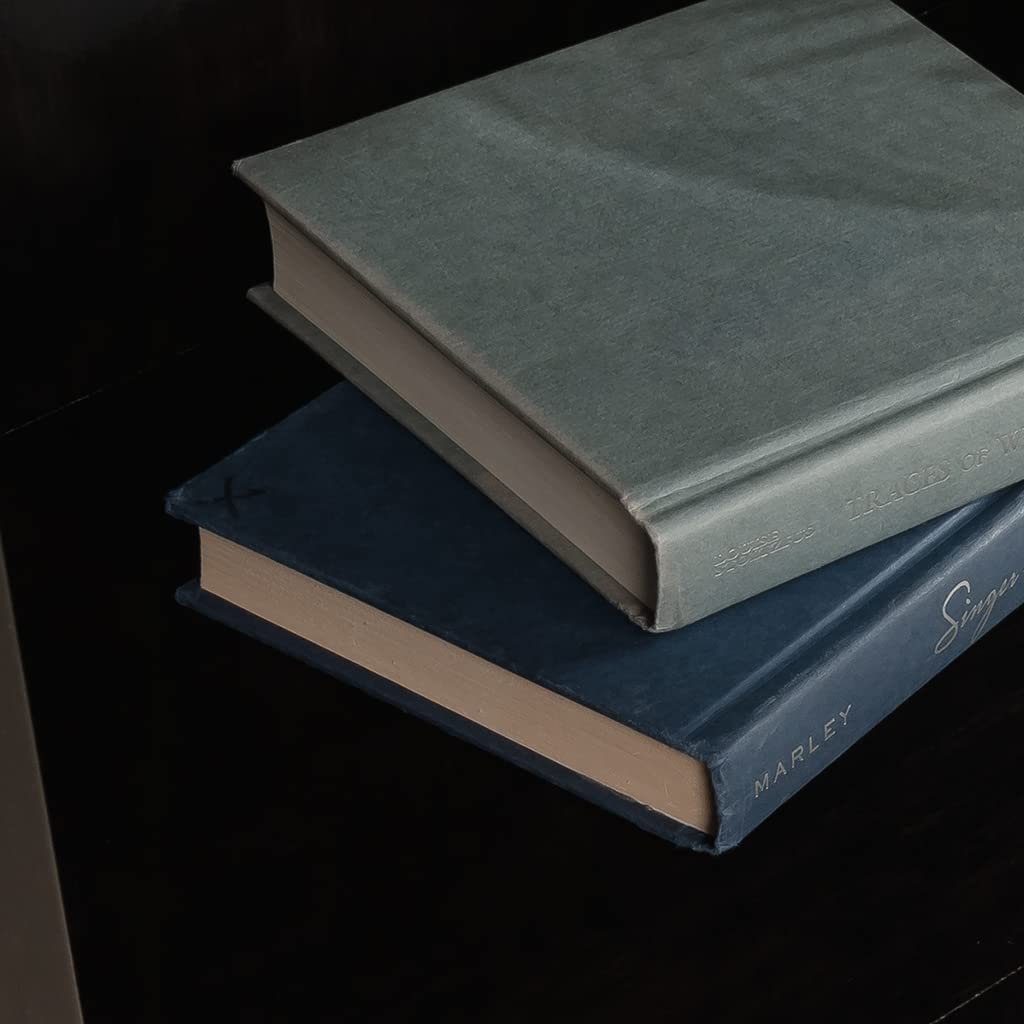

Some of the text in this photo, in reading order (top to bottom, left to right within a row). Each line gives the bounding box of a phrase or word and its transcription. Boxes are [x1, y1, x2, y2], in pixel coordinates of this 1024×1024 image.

[846, 458, 952, 521] TRACES
[960, 447, 989, 473] OF
[934, 580, 1020, 655] Singer
[754, 703, 852, 798] MARLEY
